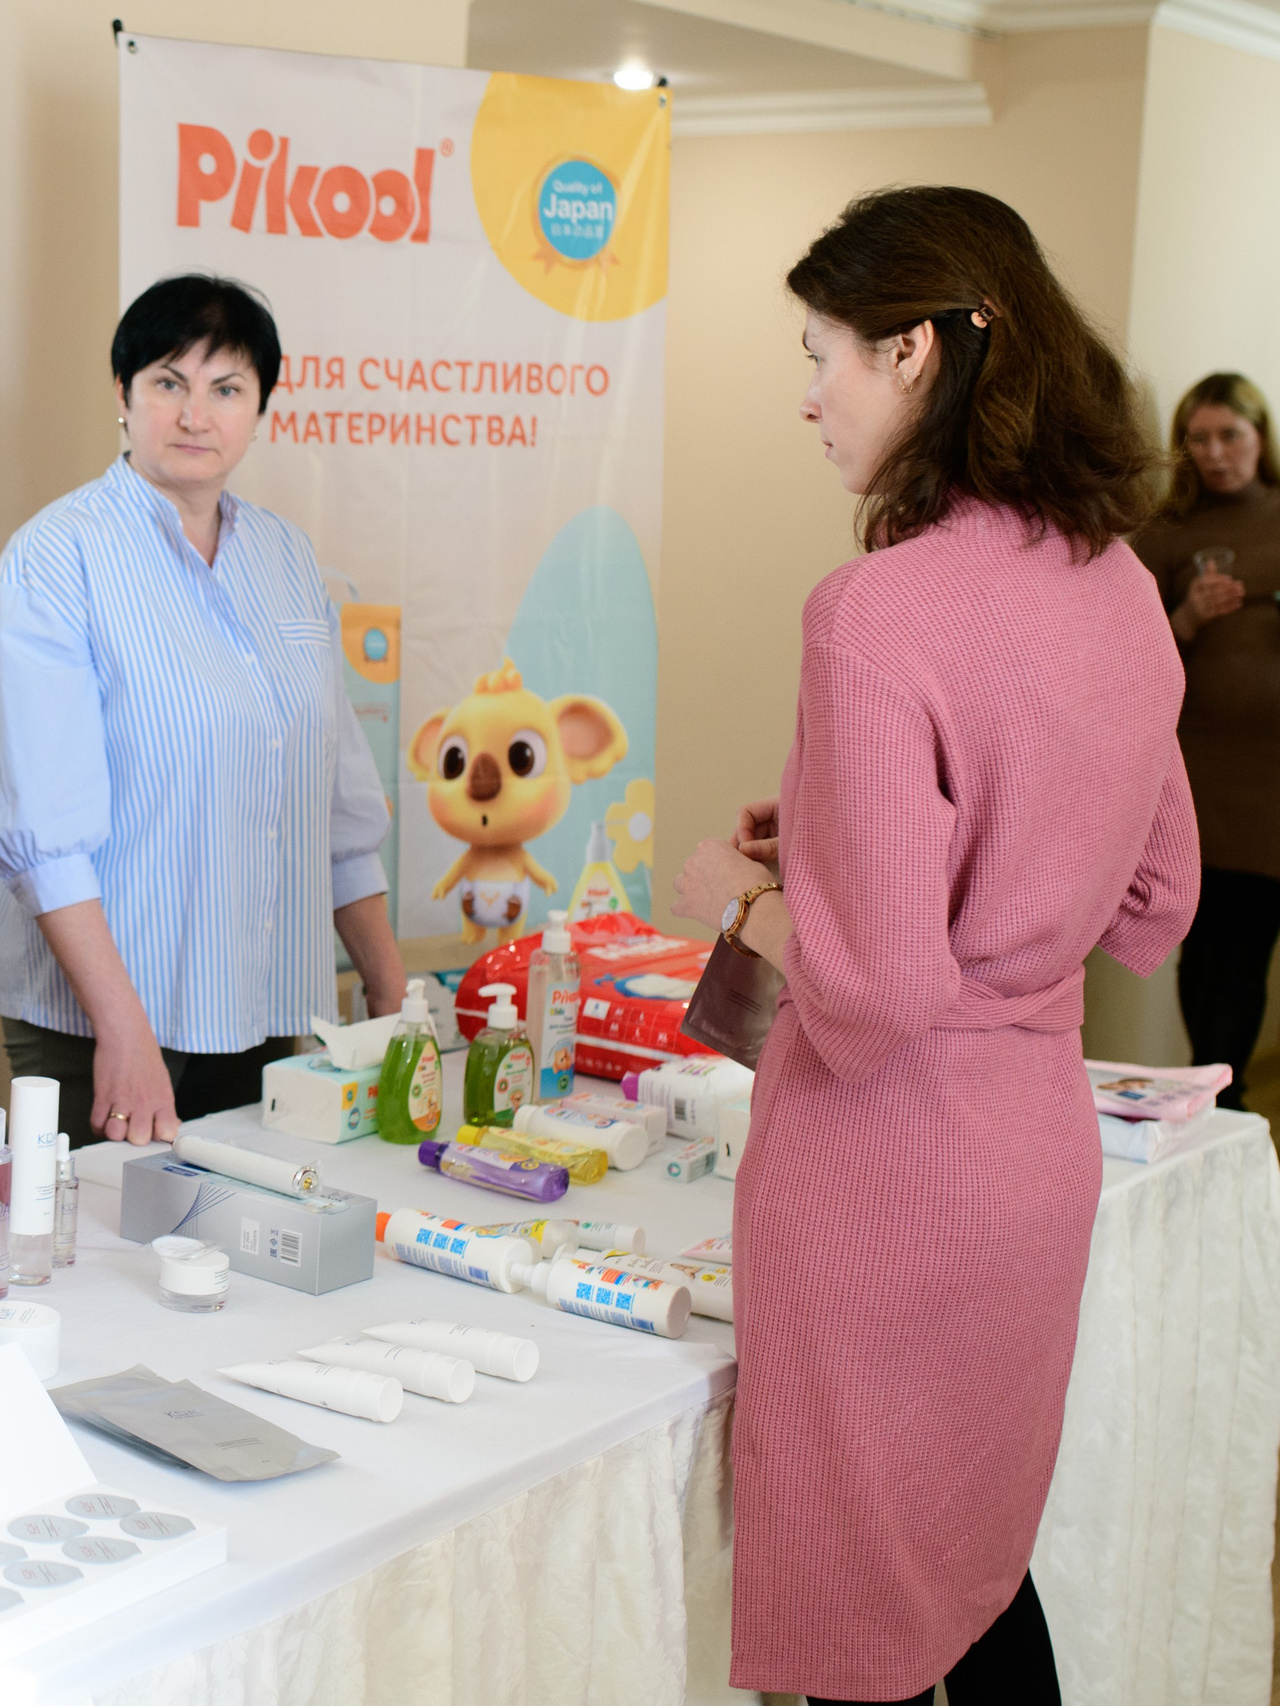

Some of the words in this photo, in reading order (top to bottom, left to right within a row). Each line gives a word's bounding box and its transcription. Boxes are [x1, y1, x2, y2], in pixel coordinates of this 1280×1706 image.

[177, 122, 436, 243] Pikool
[543, 193, 614, 225] Japan
[271, 355, 345, 394] ДЛЯ
[358, 357, 610, 396] СЧАСТЛИВОГО
[270, 410, 538, 447] МАТЕРИНСТВА!
